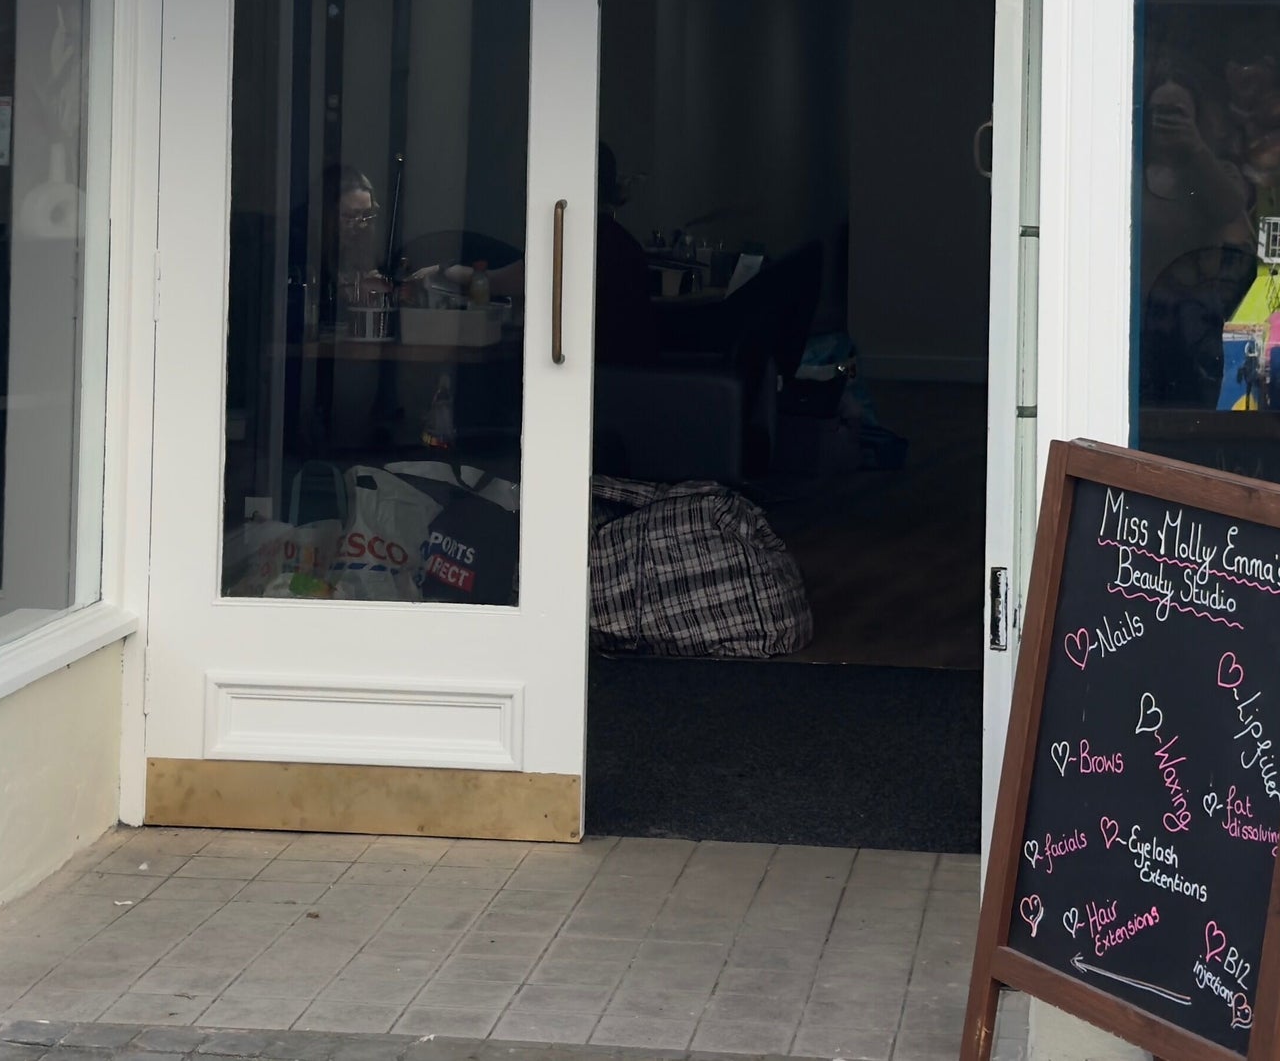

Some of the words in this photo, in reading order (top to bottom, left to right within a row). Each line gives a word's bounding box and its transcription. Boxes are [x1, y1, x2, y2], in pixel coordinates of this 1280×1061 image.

[1099, 487, 1149, 546] Miss
[1157, 508, 1218, 584] Molly
[1114, 546, 1174, 622] Beauty
[1180, 568, 1237, 612] Studio
[1096, 611, 1144, 658] Nails
[1079, 739, 1124, 774] Brows
[1154, 735, 1192, 833] Waxing
[1128, 824, 1179, 869] Eyelash
[1139, 861, 1208, 903] Extentions
[1085, 899, 1118, 939] Hair
[1094, 905, 1160, 957] Extensions
[1223, 946, 1251, 991] B12
